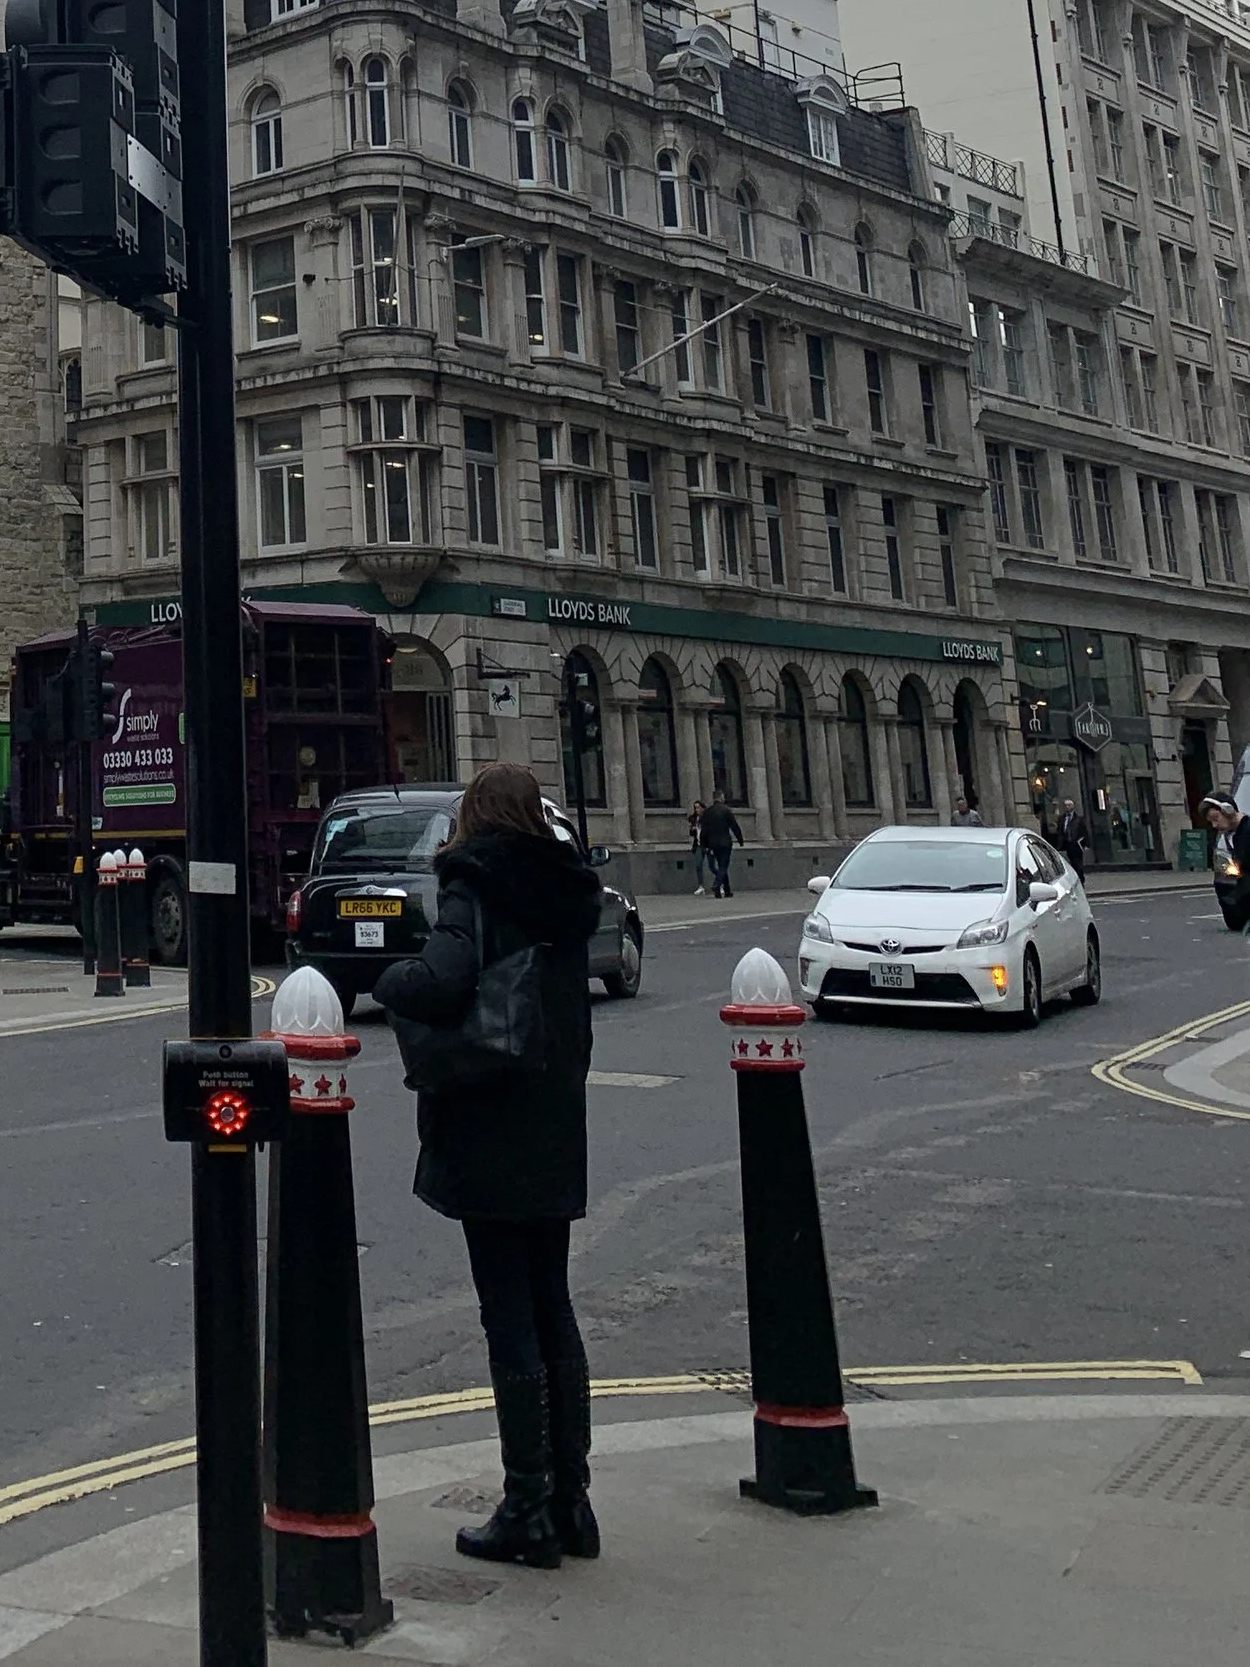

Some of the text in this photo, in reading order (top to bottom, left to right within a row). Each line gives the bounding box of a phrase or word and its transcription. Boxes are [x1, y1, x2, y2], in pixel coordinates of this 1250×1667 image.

[548, 597, 595, 621] LLOYDS
[597, 603, 632, 626] BANK
[942, 641, 1000, 662] LLOYDS BANK
[126, 709, 159, 733] simply
[103, 747, 174, 769] 03330 433 033
[345, 902, 396, 914] LR66 YKC
[198, 1079, 254, 1089] Wait for signal
[203, 1071, 249, 1079] Push button
